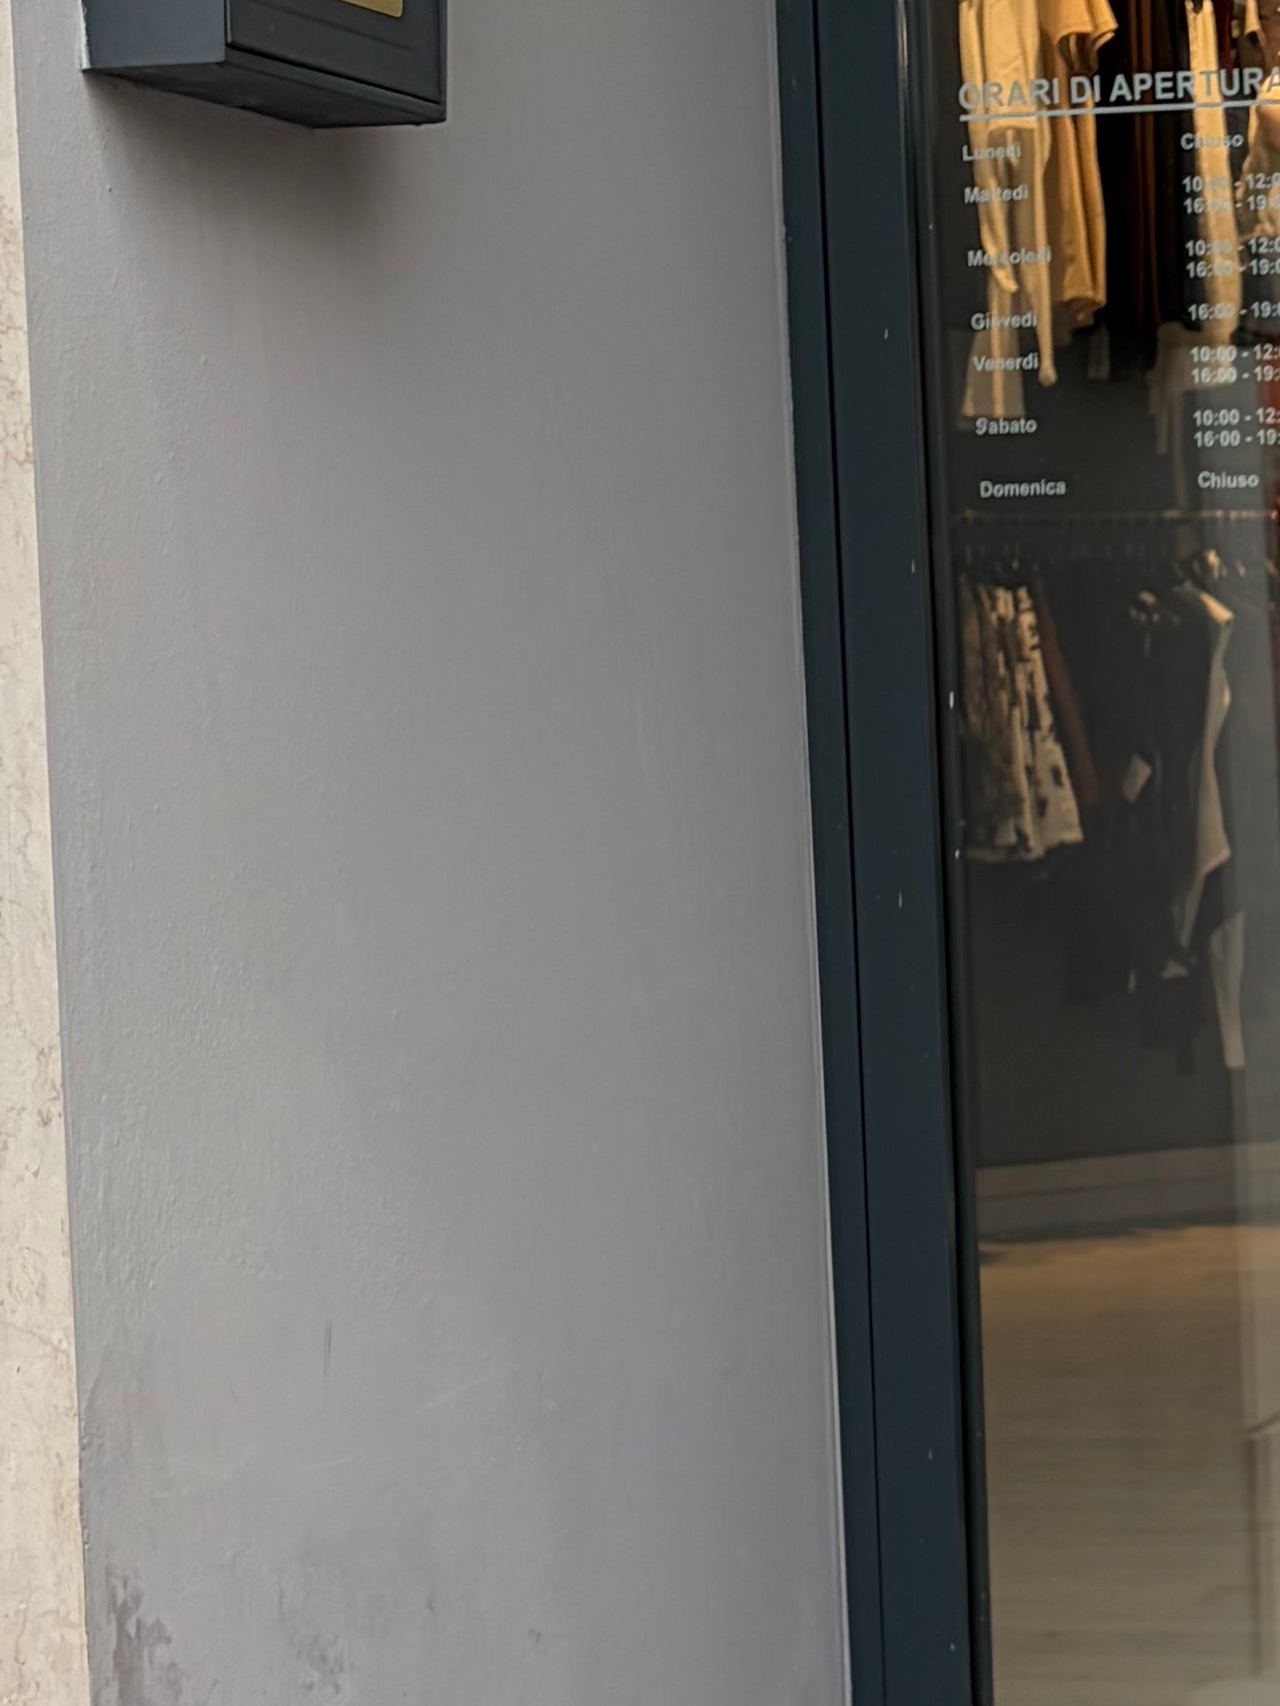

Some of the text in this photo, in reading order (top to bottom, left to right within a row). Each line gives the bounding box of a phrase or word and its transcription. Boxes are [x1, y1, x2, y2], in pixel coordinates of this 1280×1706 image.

[958, 78, 1060, 110] ORARI
[1070, 76, 1101, 104] DI
[1180, 133, 1244, 150] Chso
[1188, 302, 1236, 321] 16:00
[1190, 345, 1238, 363] 10:00
[1191, 366, 1238, 384] 16:00
[975, 416, 1038, 436] Sabato
[1193, 408, 1240, 427] 10:00
[1193, 429, 1241, 448] 16:00
[979, 478, 1066, 499] Domenica
[1197, 470, 1260, 490] Chiuso
